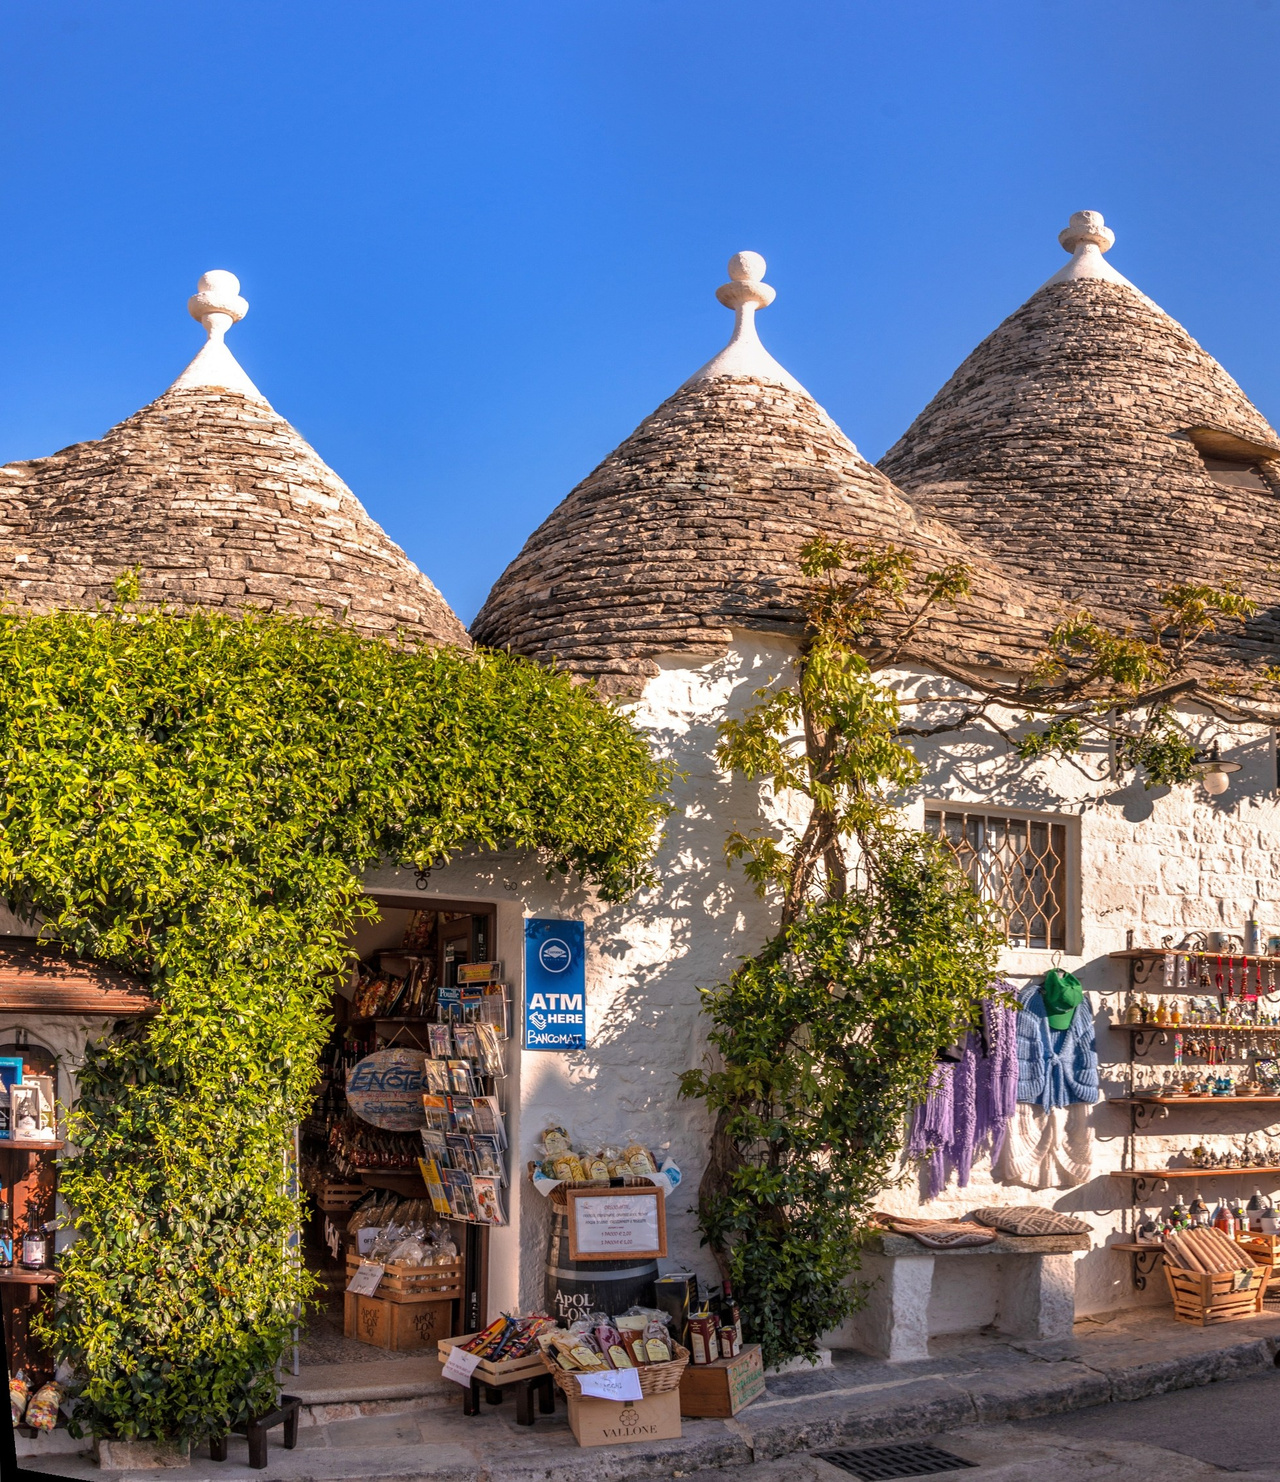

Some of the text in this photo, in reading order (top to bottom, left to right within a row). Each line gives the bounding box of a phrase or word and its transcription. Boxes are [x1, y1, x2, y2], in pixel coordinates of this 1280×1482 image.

[529, 993, 583, 1010] ATM
[547, 1014, 583, 1024] HERE
[602, 1424, 658, 1439] VALLONE
